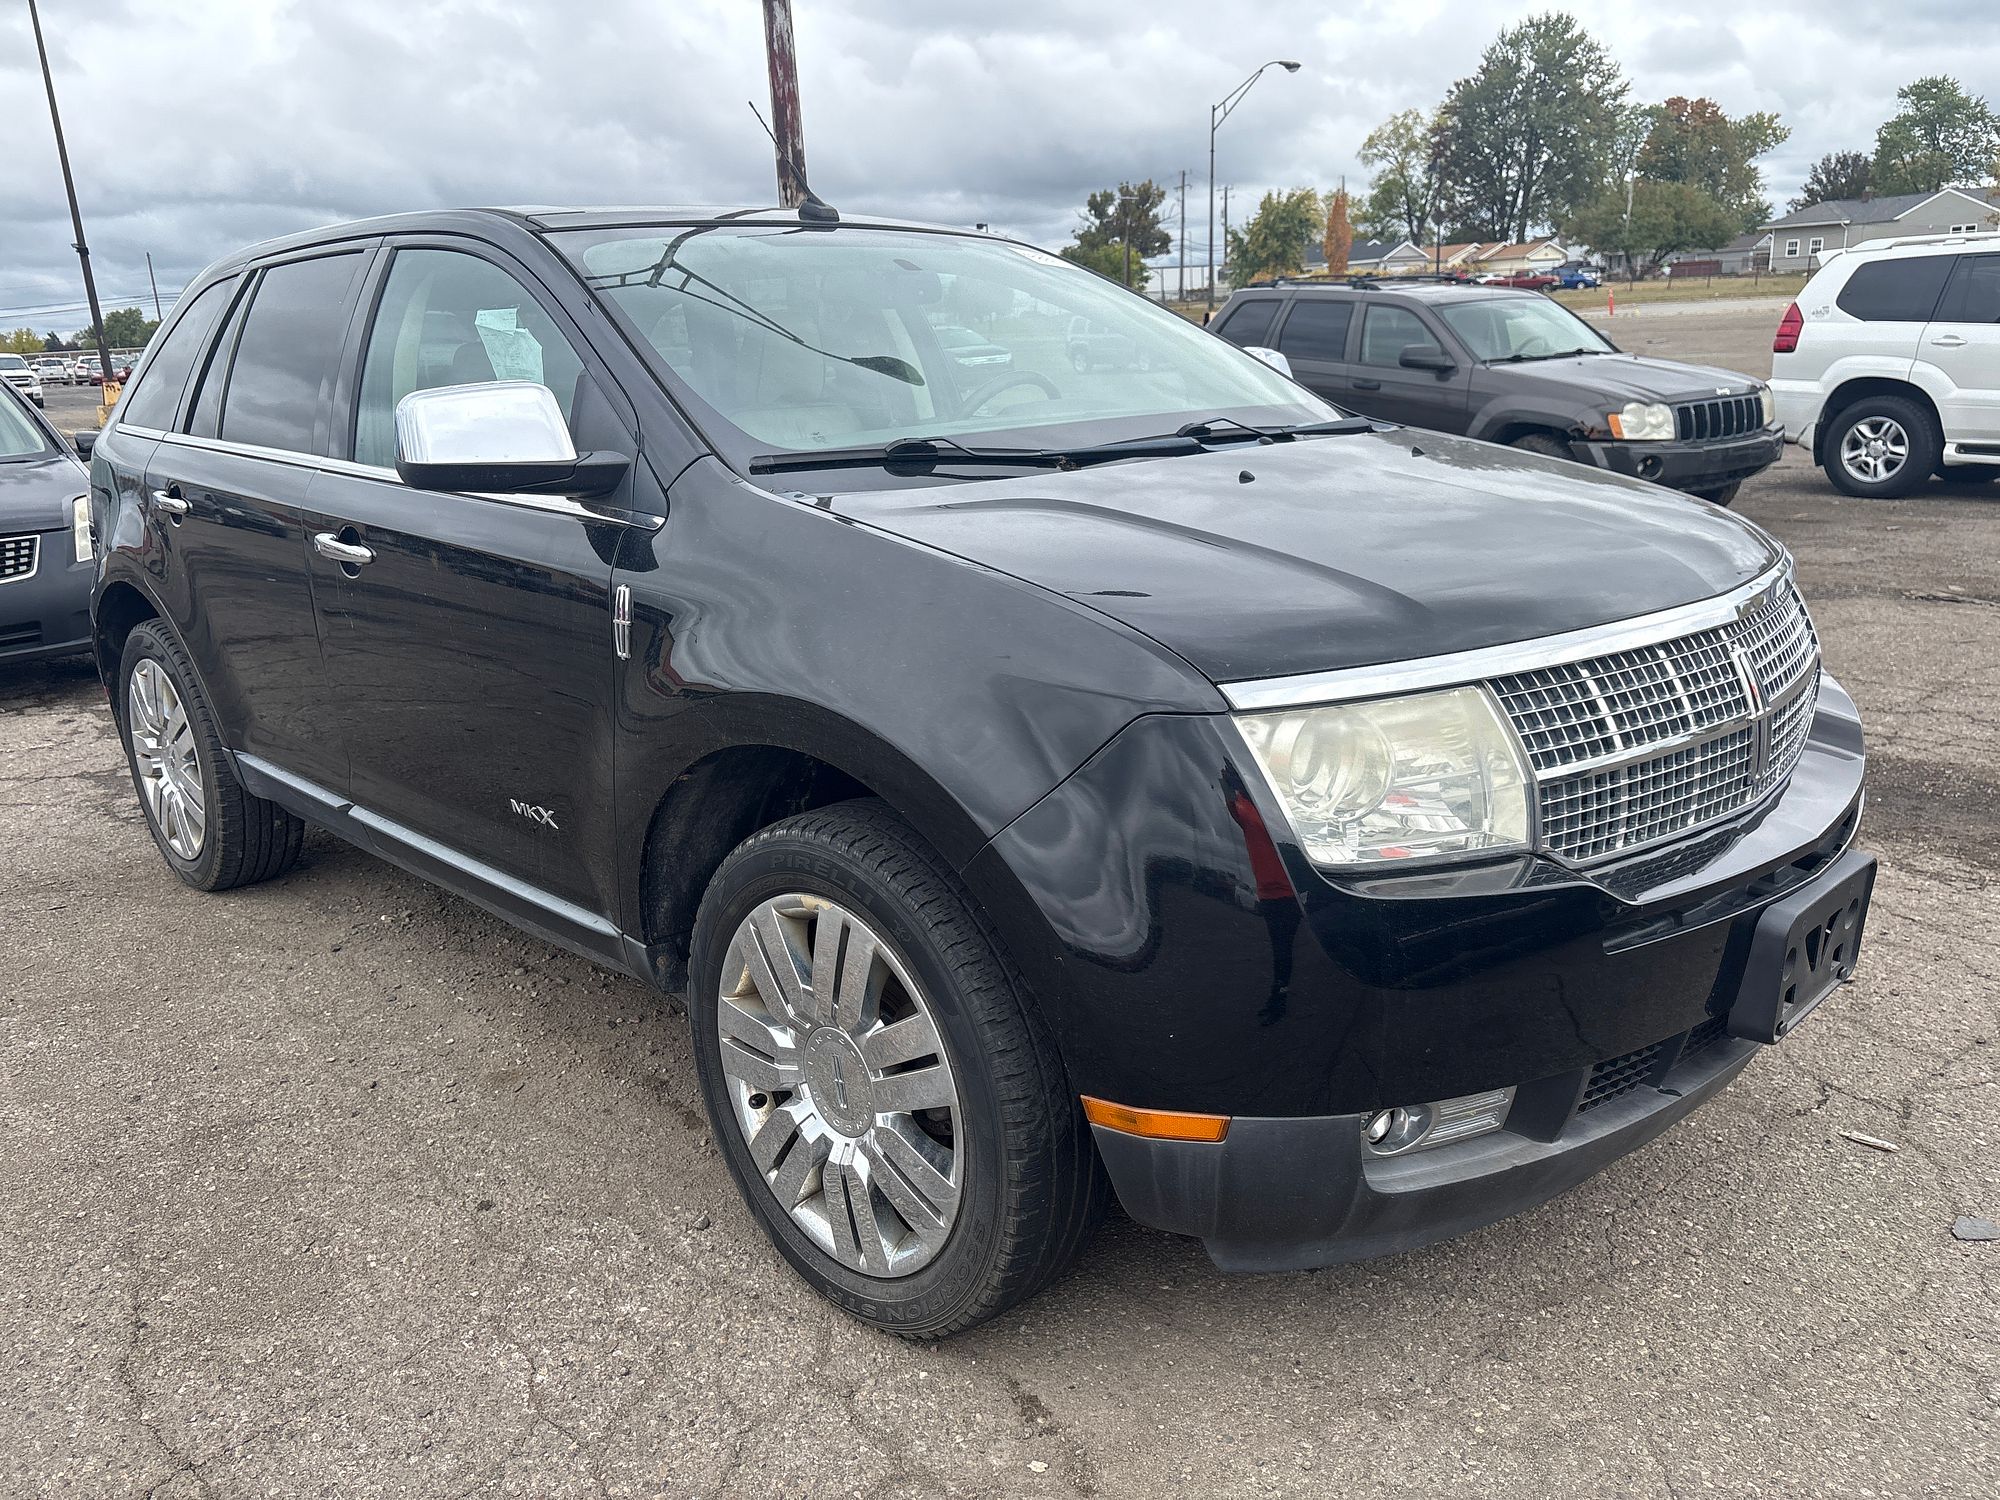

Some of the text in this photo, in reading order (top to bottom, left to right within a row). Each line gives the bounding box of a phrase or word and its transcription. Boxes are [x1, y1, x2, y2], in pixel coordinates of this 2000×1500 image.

[509, 798, 560, 830] MKX
[770, 854, 876, 905] PIRELLI
[887, 1218, 986, 1322] SCORPION
